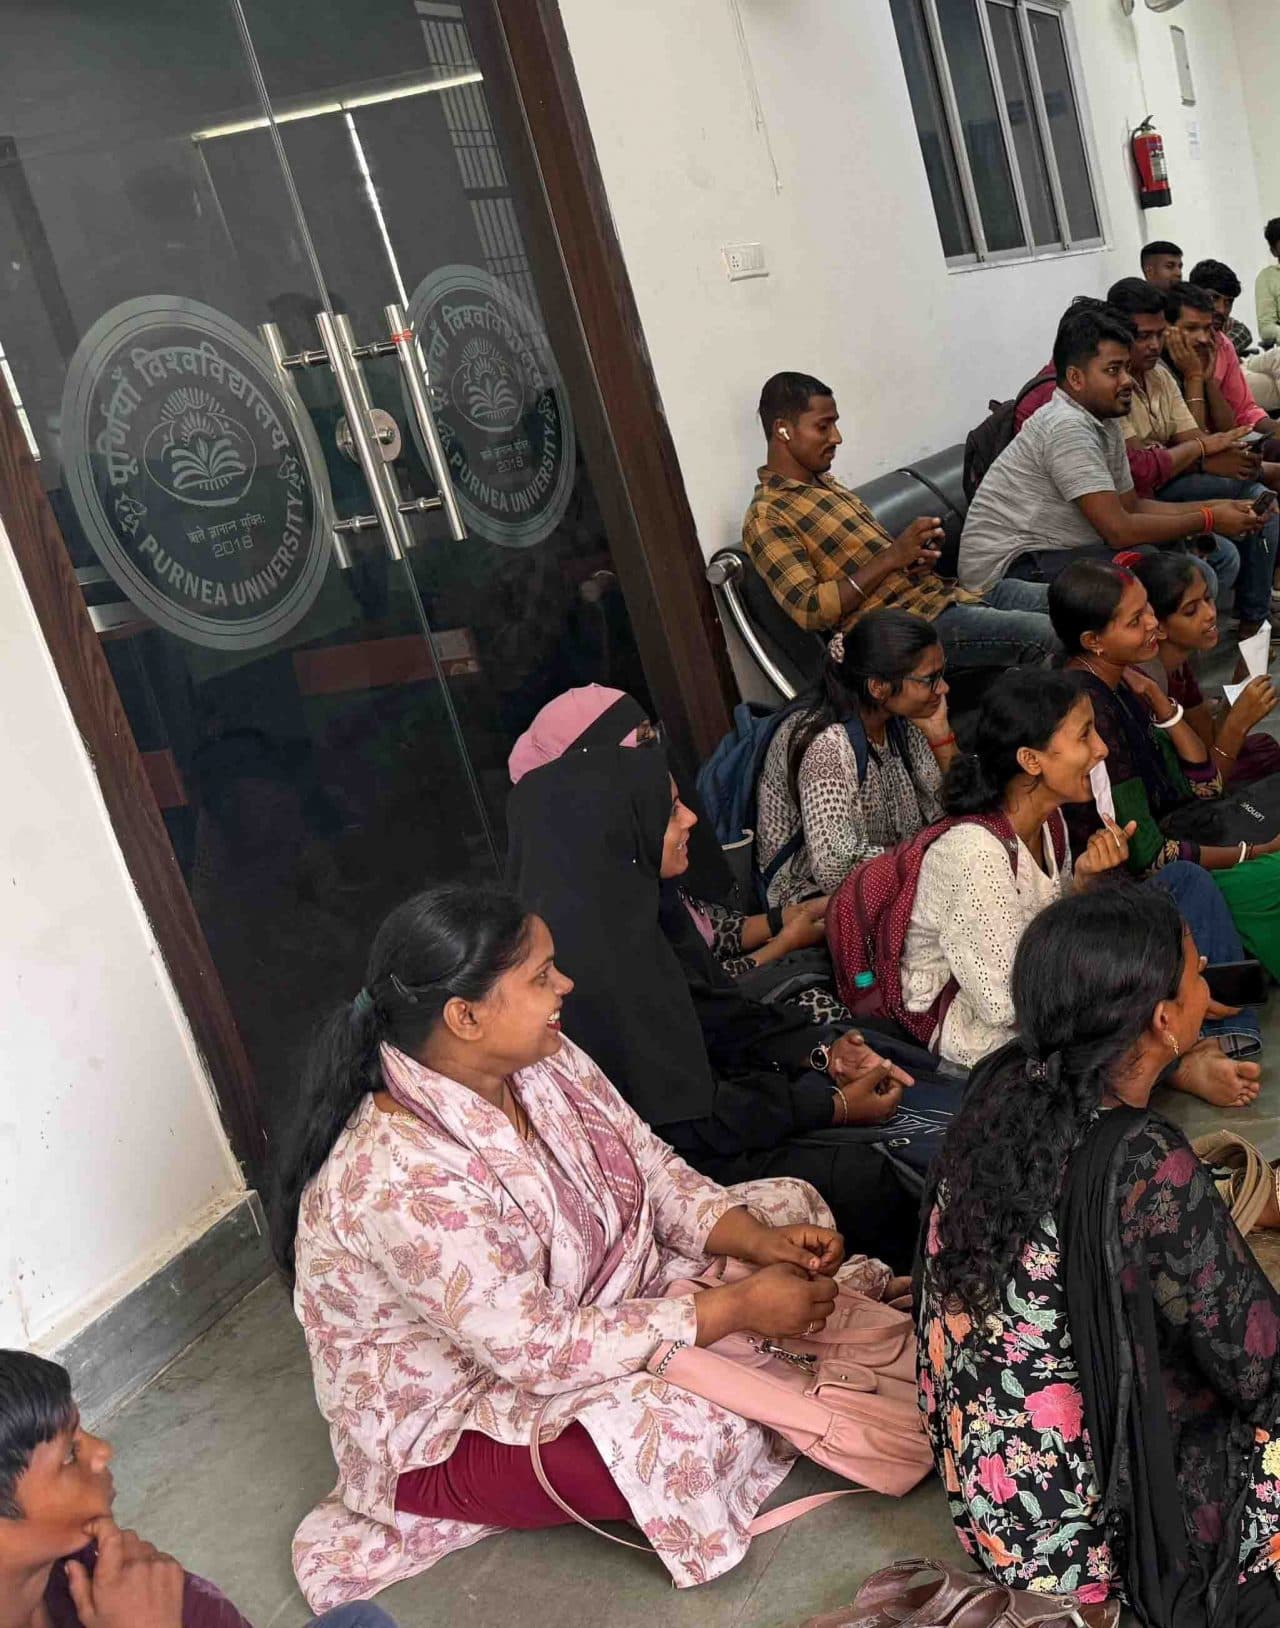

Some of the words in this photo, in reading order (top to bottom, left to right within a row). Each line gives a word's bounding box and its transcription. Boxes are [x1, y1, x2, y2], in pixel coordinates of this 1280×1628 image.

[131, 341, 290, 450] विश्वविद्यालय
[450, 452, 510, 513] PURNEA
[510, 422, 556, 513] UNIVERSITY
[138, 534, 228, 607] PURNEA
[231, 492, 304, 606] UNIVERSITY
